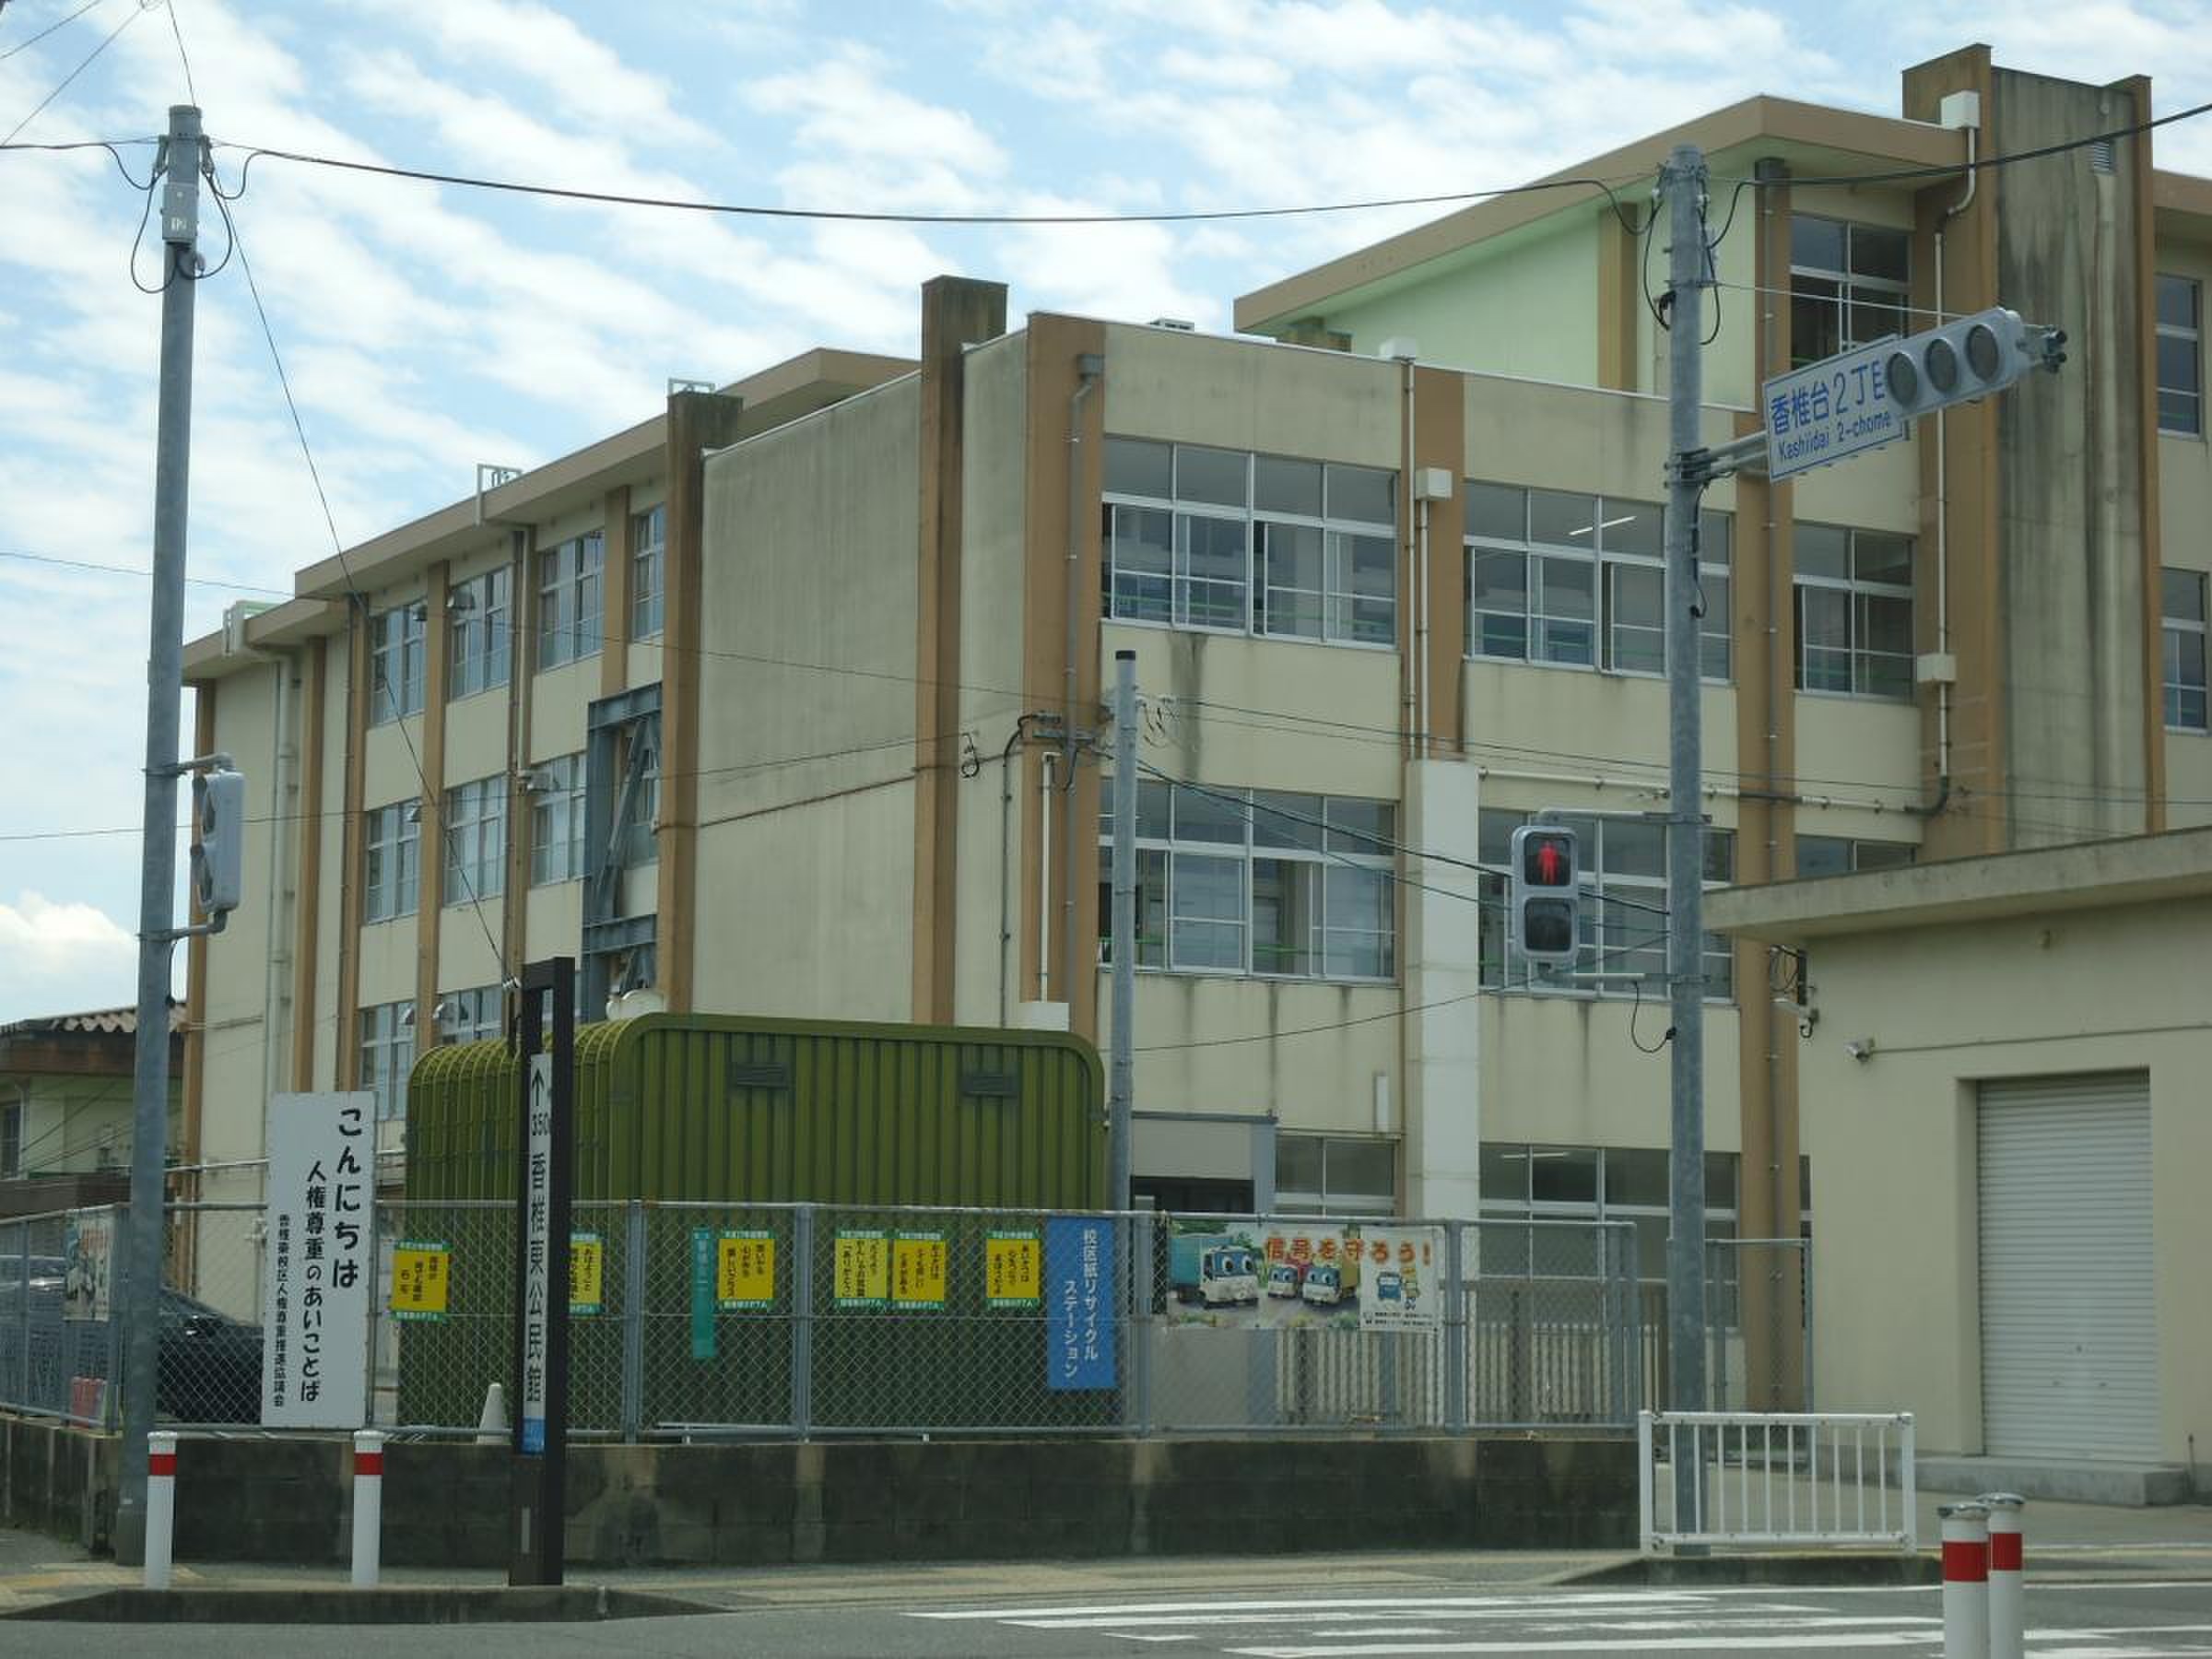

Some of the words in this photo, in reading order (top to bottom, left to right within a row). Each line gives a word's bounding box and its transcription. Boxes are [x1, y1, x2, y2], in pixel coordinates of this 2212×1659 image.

[1771, 360, 1886, 436] 香椎台2丁目
[1779, 432, 1830, 460] Kashiidai
[1837, 412, 1891, 442] 2-chome
[332, 1107, 362, 1289] こんにちは
[300, 1159, 327, 1403] 人権尊重のあいことば
[1064, 1280, 1078, 1379] ステーション
